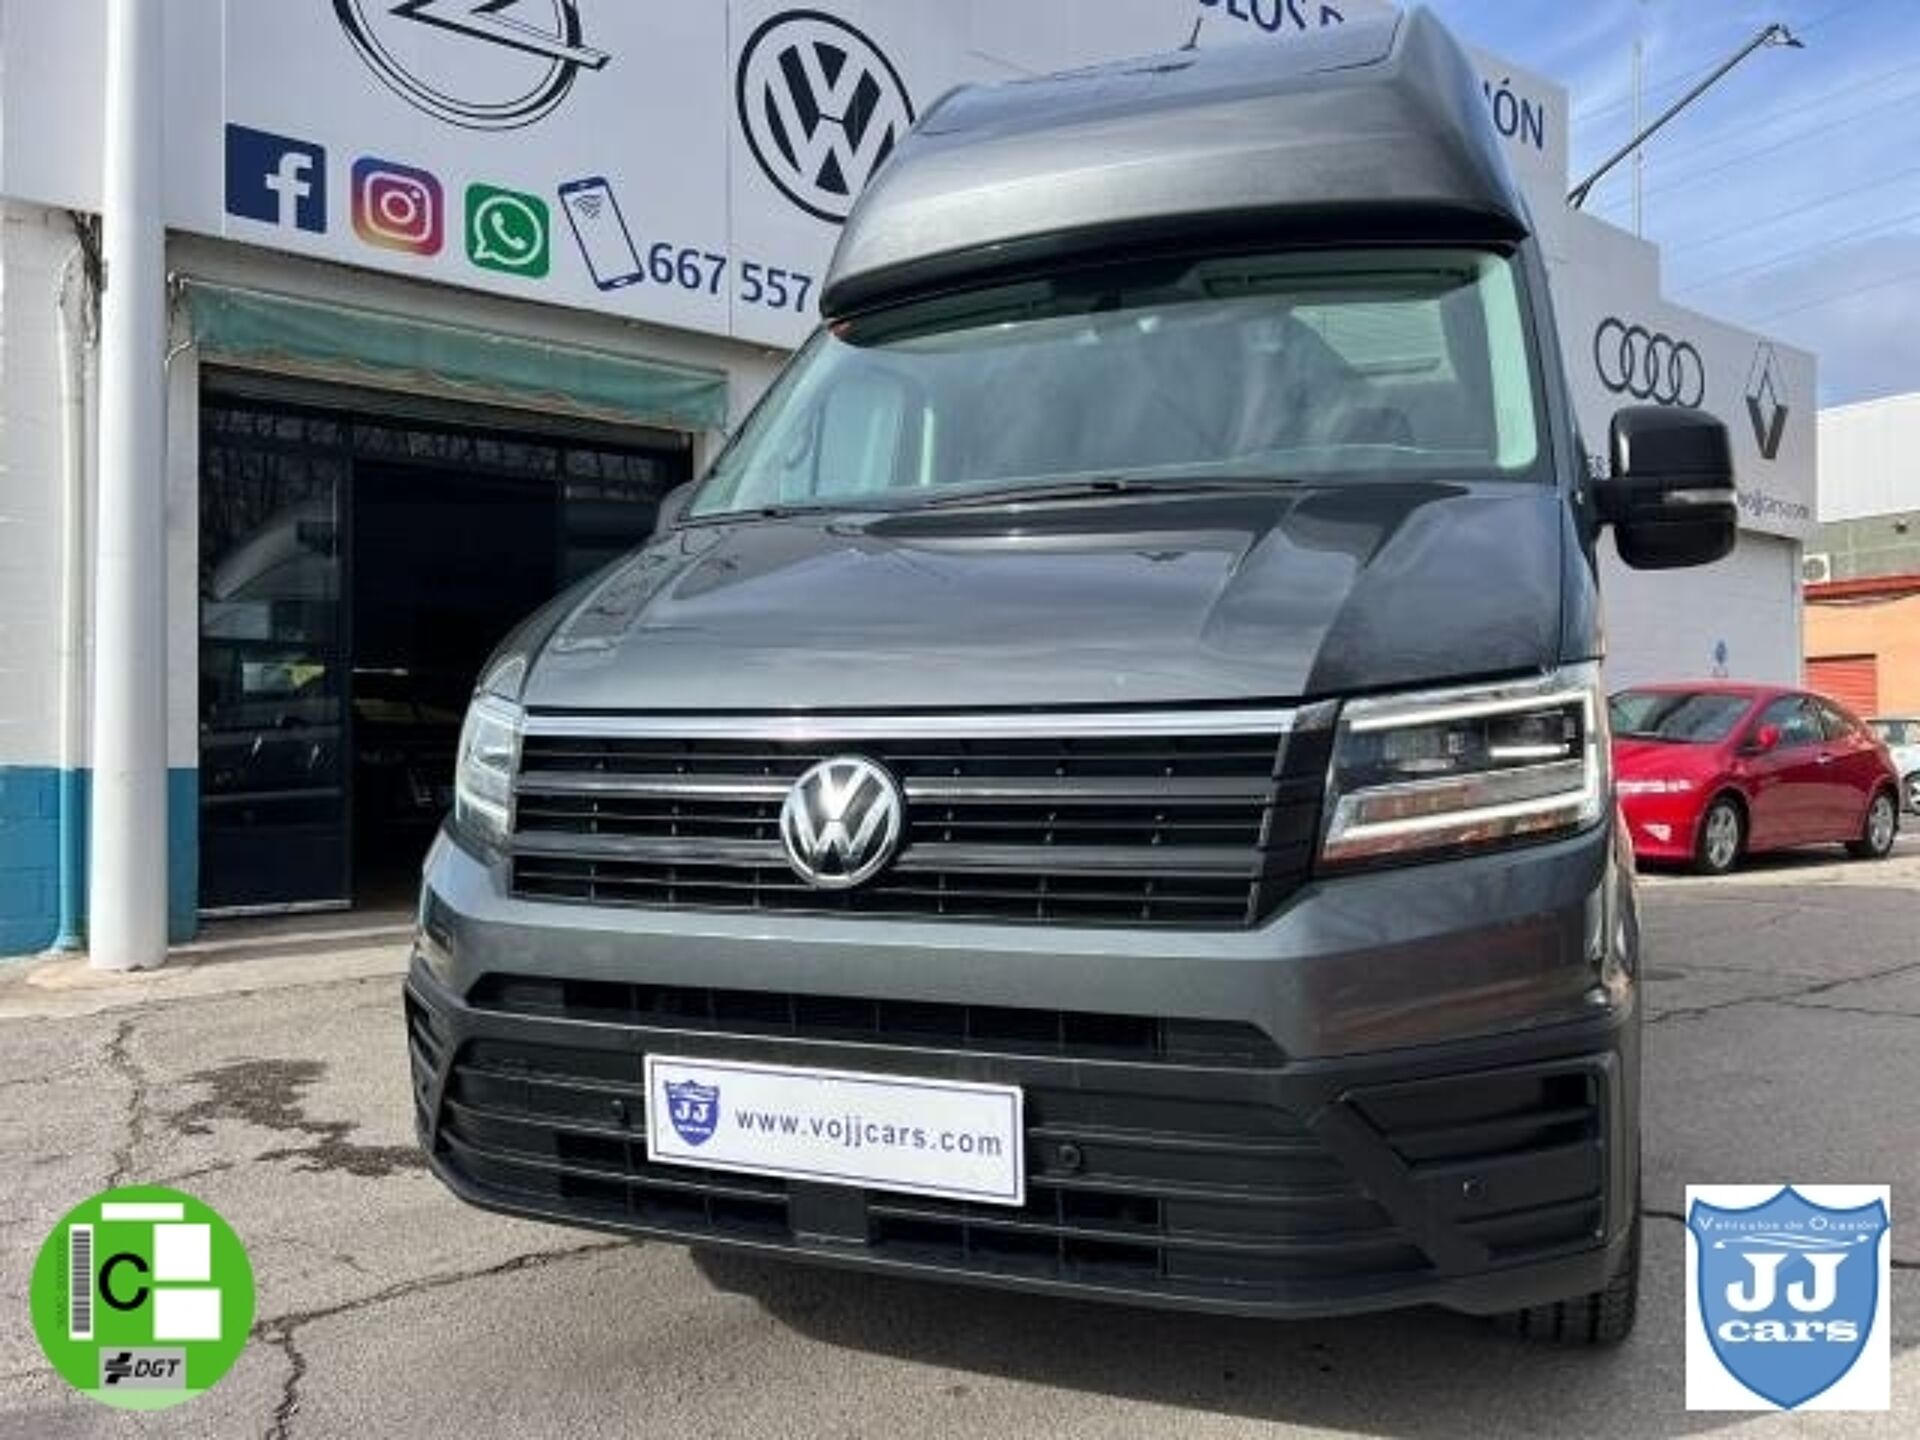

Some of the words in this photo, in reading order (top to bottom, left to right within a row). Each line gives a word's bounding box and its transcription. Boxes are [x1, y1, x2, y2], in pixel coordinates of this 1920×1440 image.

[649, 242, 727, 295] 667
[741, 262, 812, 313] 557
[735, 1108, 1004, 1156] www.vojjcars.com
